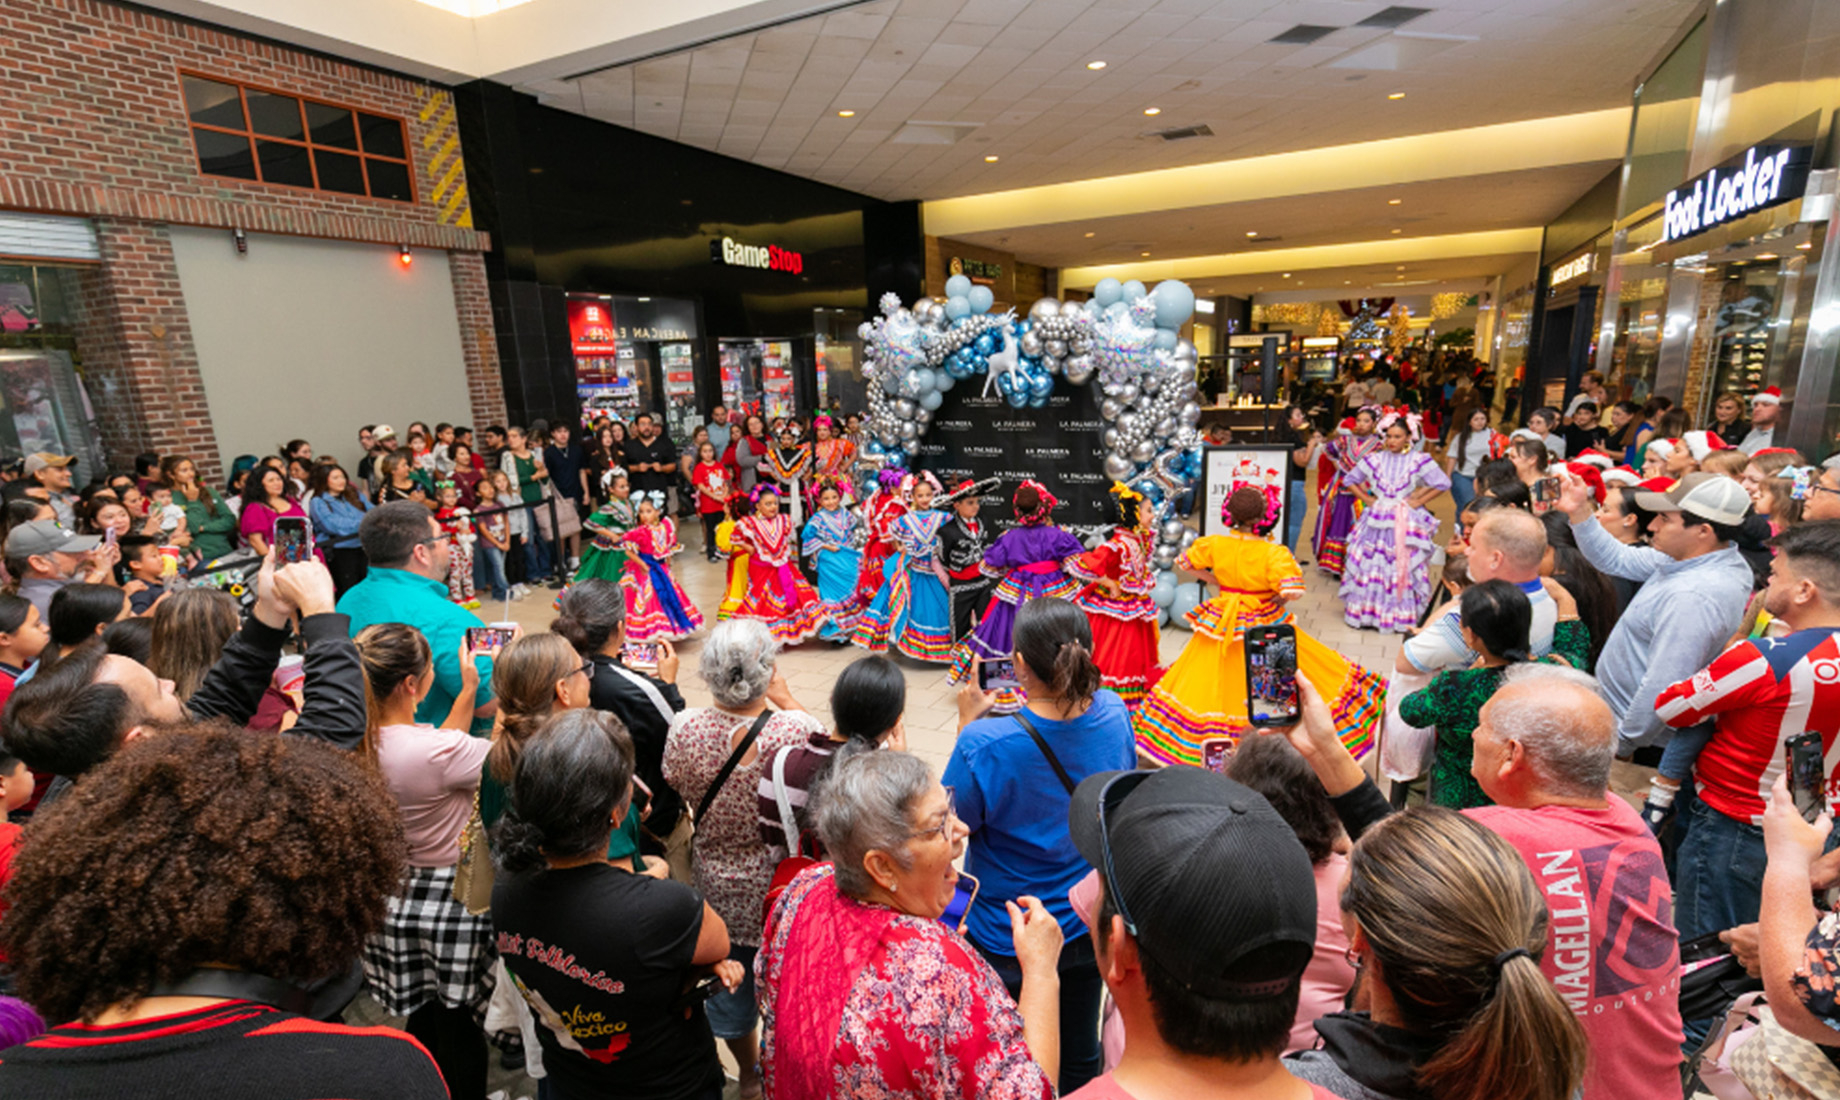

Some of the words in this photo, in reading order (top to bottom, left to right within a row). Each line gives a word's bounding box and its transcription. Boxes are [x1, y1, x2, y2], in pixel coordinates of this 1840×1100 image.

[1663, 180, 1703, 241] Foot
[1702, 147, 1790, 226] Locker
[722, 236, 803, 275] GameStop
[1536, 849, 1591, 1016] MAGELLAN
[562, 1004, 606, 1026] Viva
